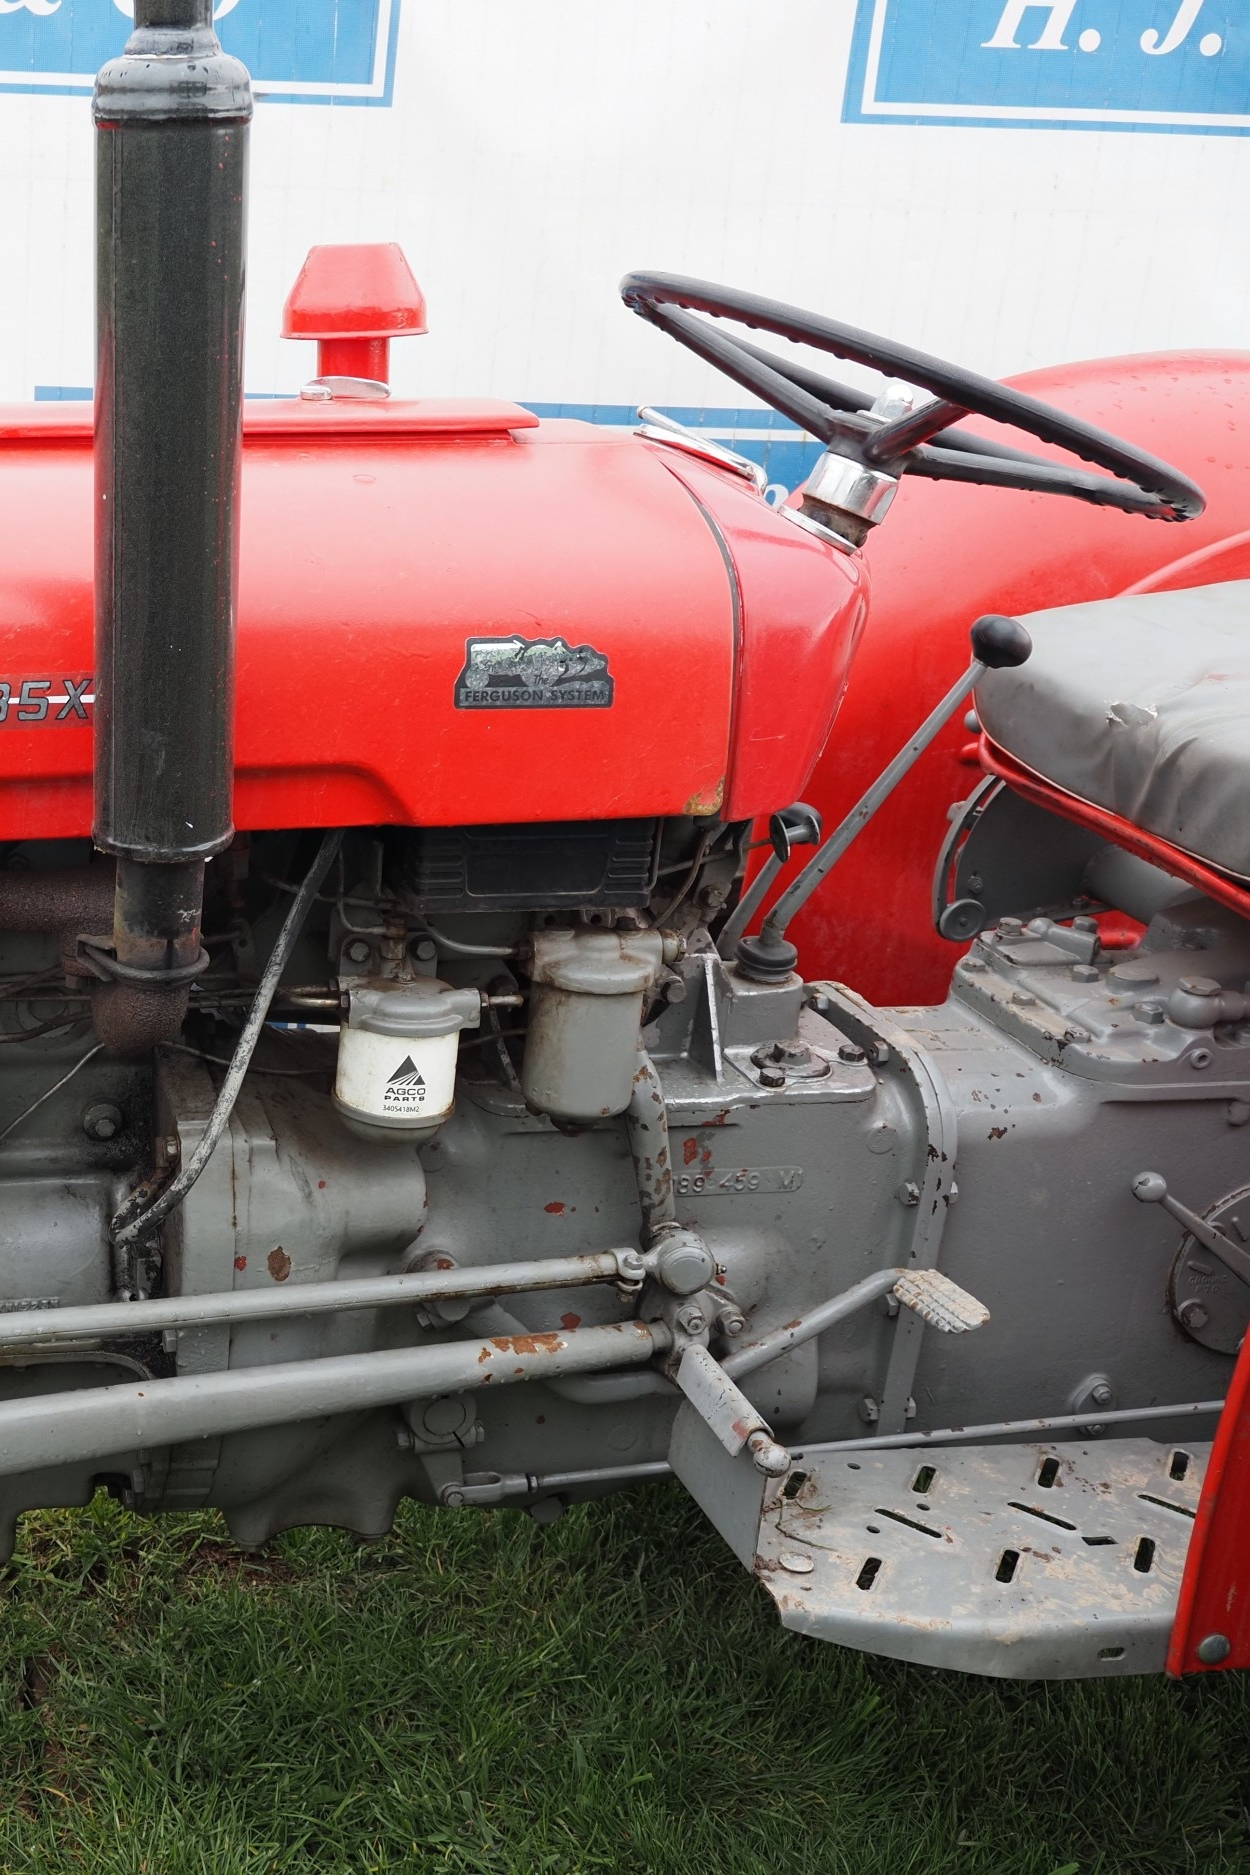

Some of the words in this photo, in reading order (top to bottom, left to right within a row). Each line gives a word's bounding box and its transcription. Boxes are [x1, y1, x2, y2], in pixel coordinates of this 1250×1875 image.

[533, 670, 549, 685] The
[465, 690, 543, 702] FERGUSON
[551, 689, 605, 701] SYSTEM
[385, 1087, 426, 1096] AGCO
